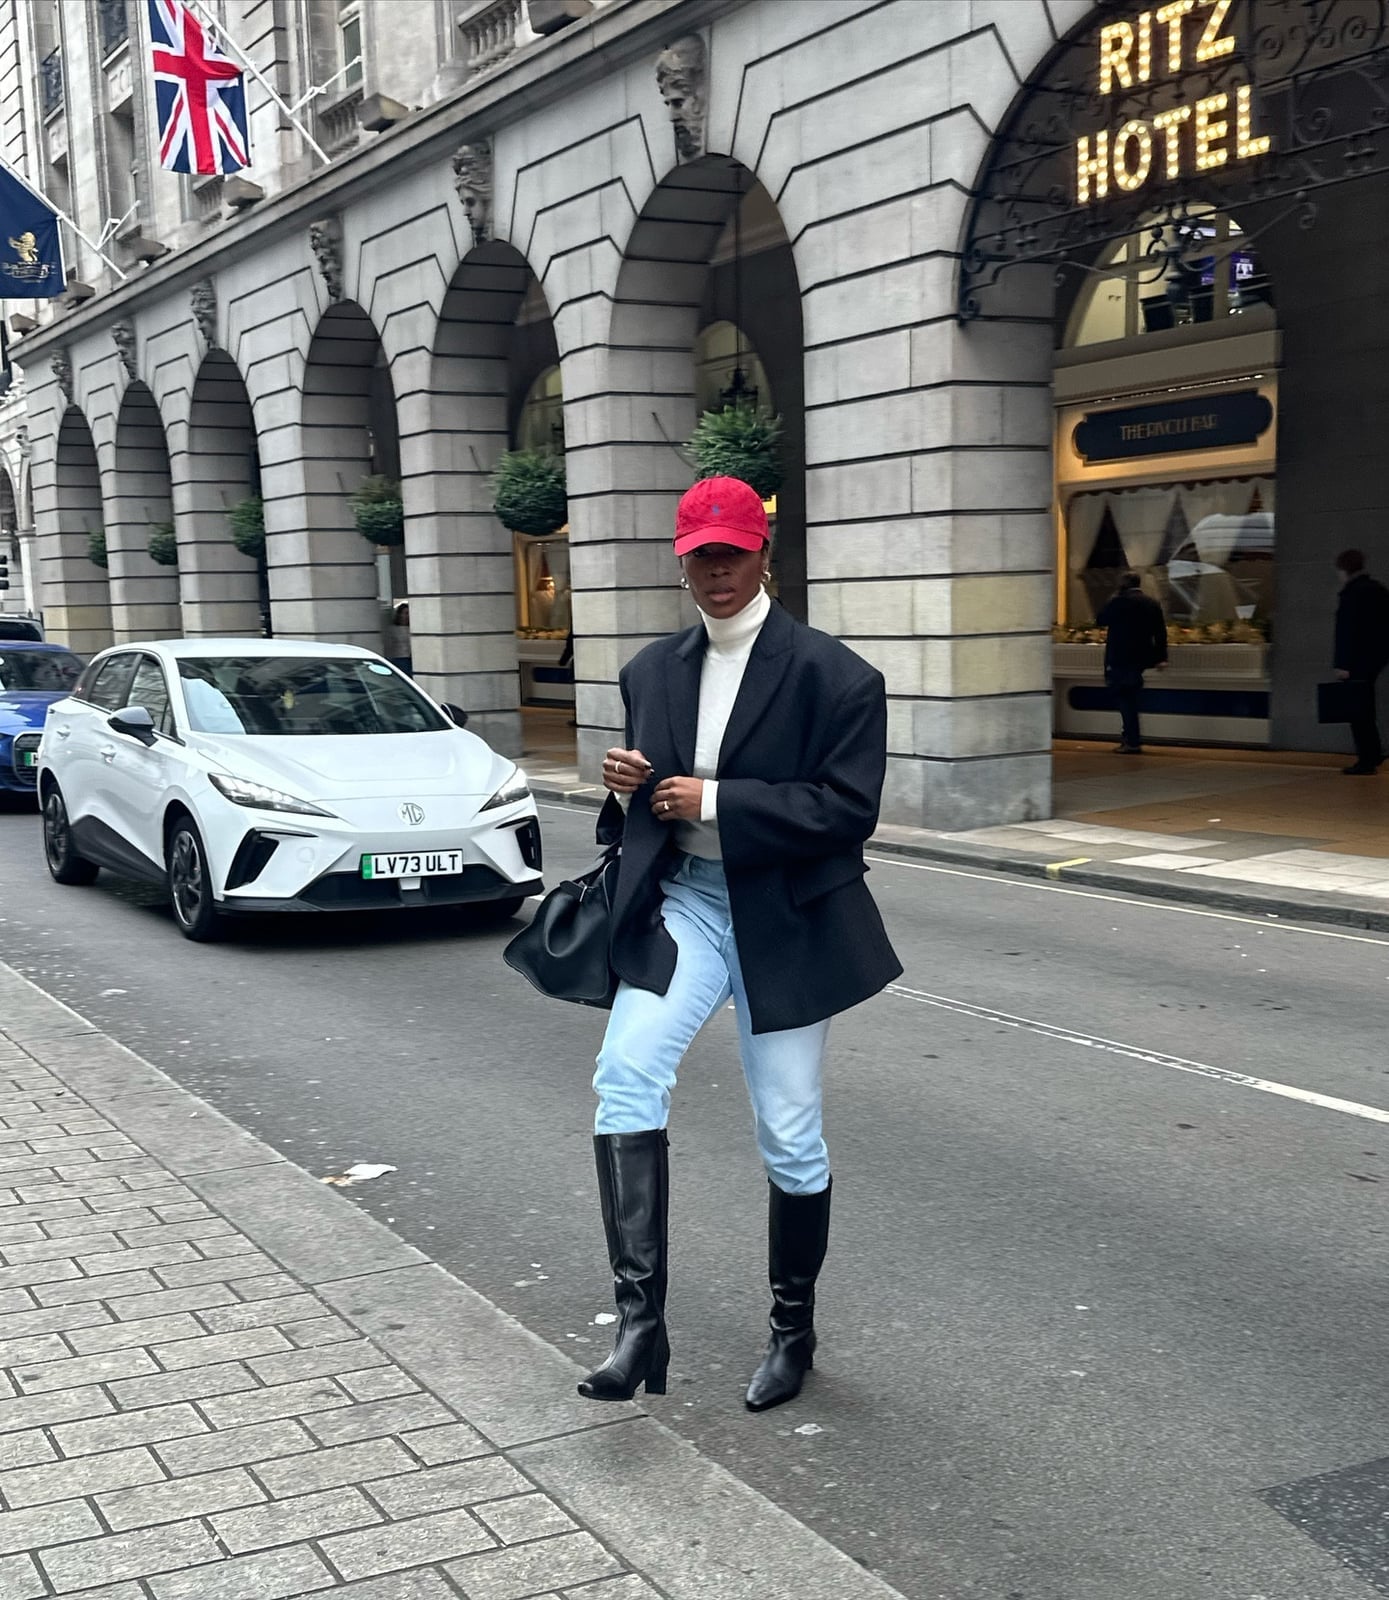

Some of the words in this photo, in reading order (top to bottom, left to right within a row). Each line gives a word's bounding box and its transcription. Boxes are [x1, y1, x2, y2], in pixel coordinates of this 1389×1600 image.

[1099, 0, 1235, 95] RITZ
[1076, 85, 1271, 204] HOTEL
[401, 802, 426, 826] MG
[374, 856, 421, 875] LV73
[425, 854, 459, 872] ULT
